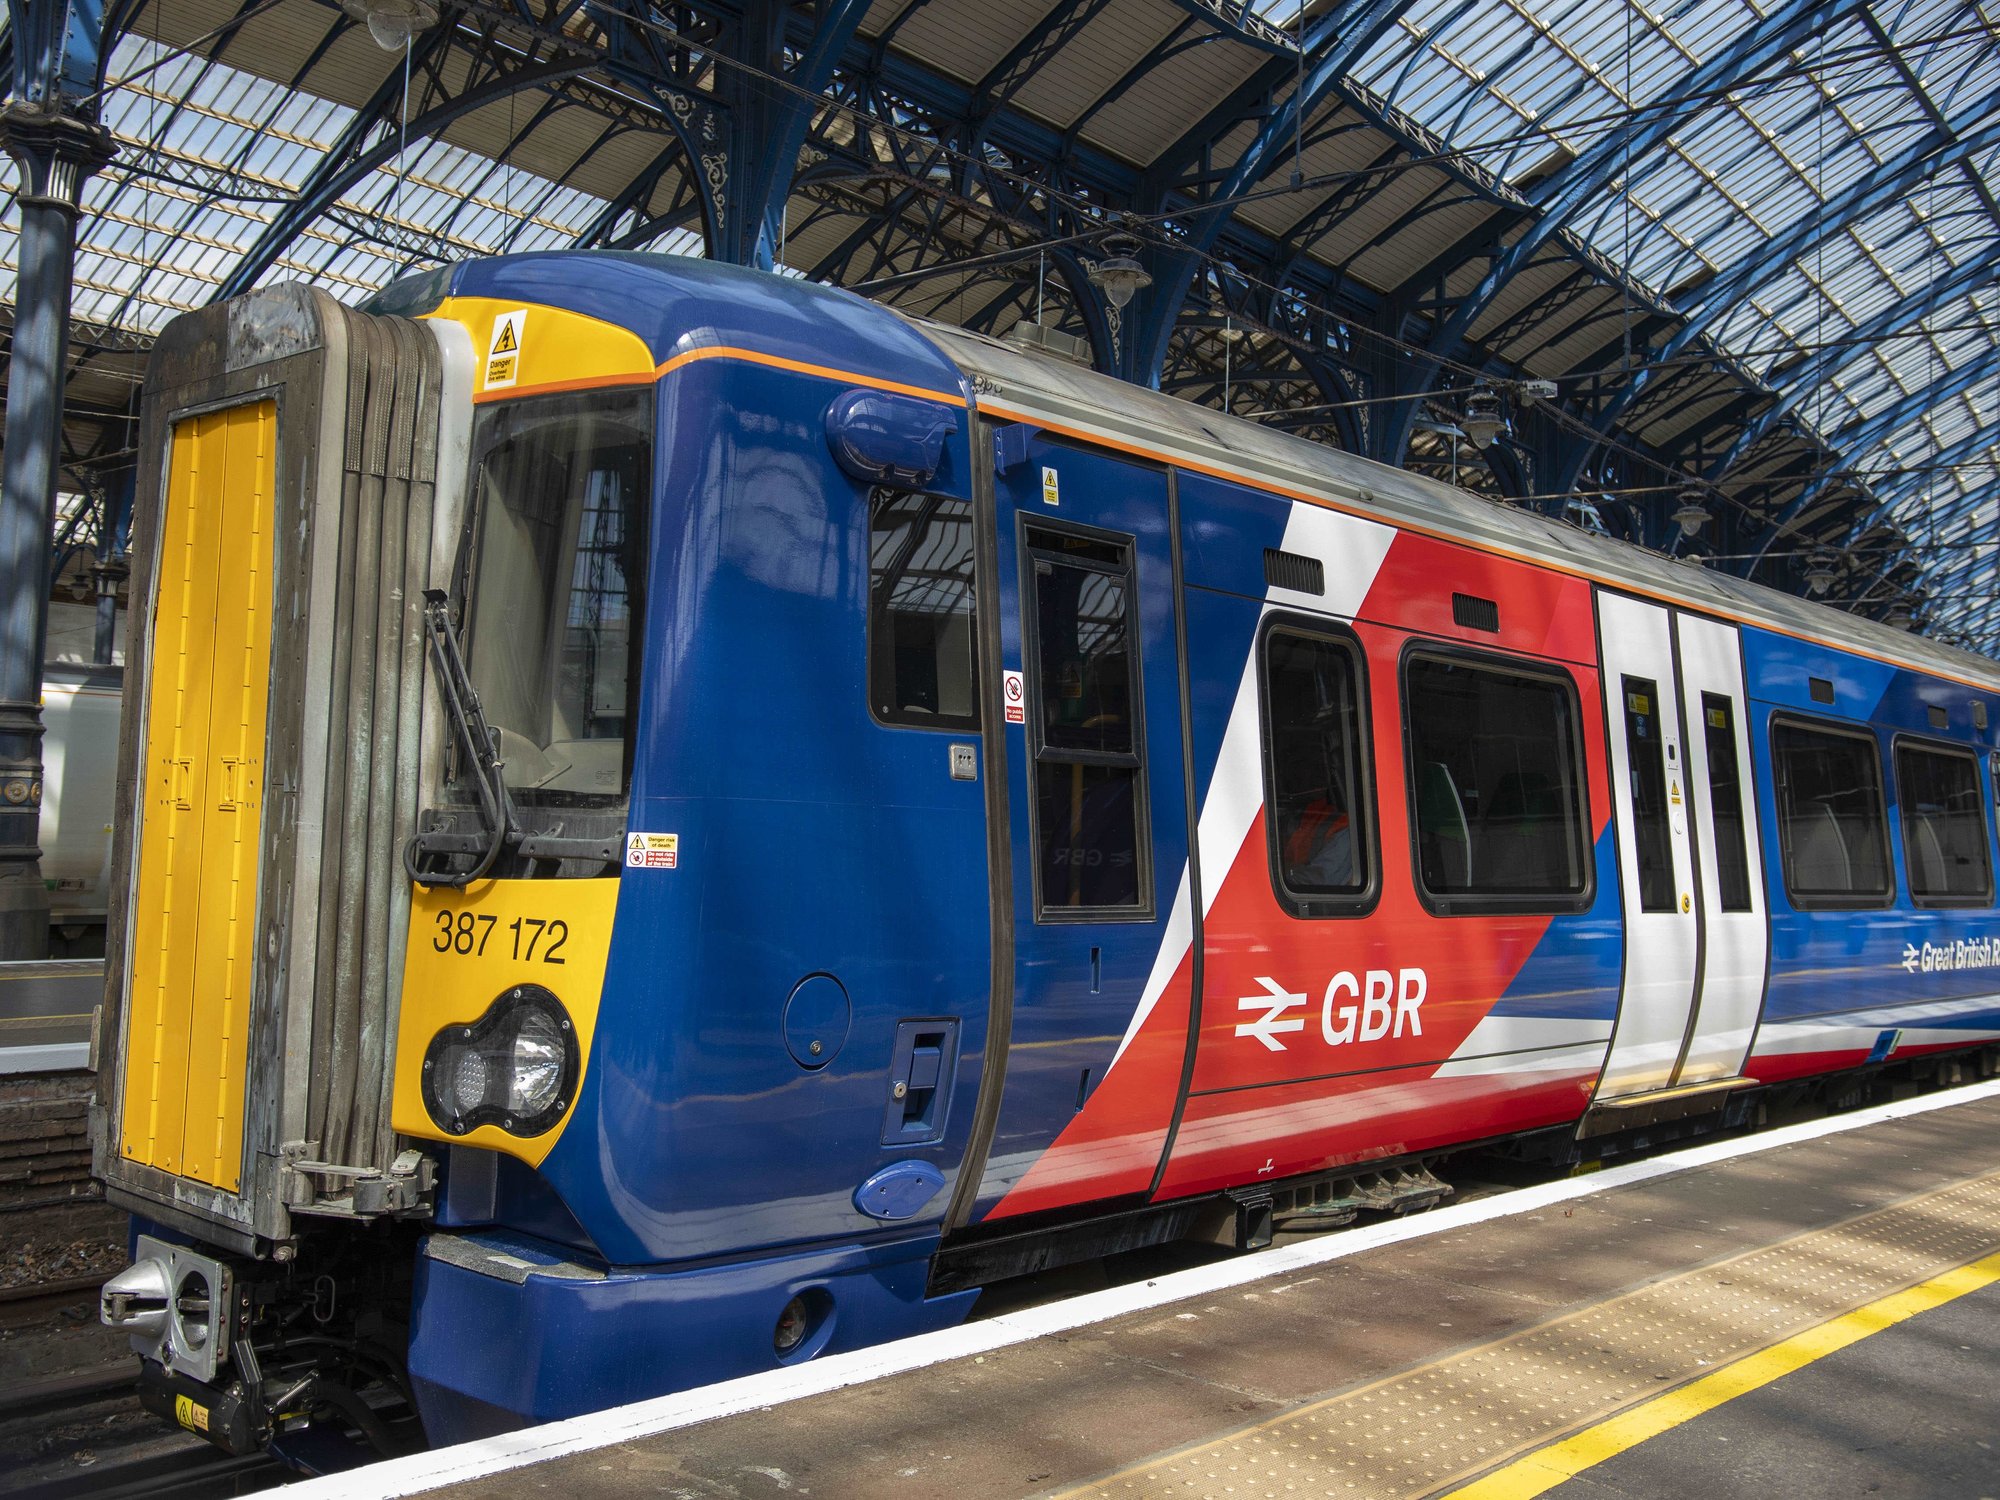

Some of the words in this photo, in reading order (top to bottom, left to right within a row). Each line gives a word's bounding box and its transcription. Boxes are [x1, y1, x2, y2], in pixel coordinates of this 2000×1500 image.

[490, 359, 511, 368] Danger
[433, 910, 498, 956] 387
[509, 917, 569, 965] 172
[1921, 941, 1956, 973] Great
[1955, 936, 1991, 969] British
[1321, 967, 1427, 1046] GBR
